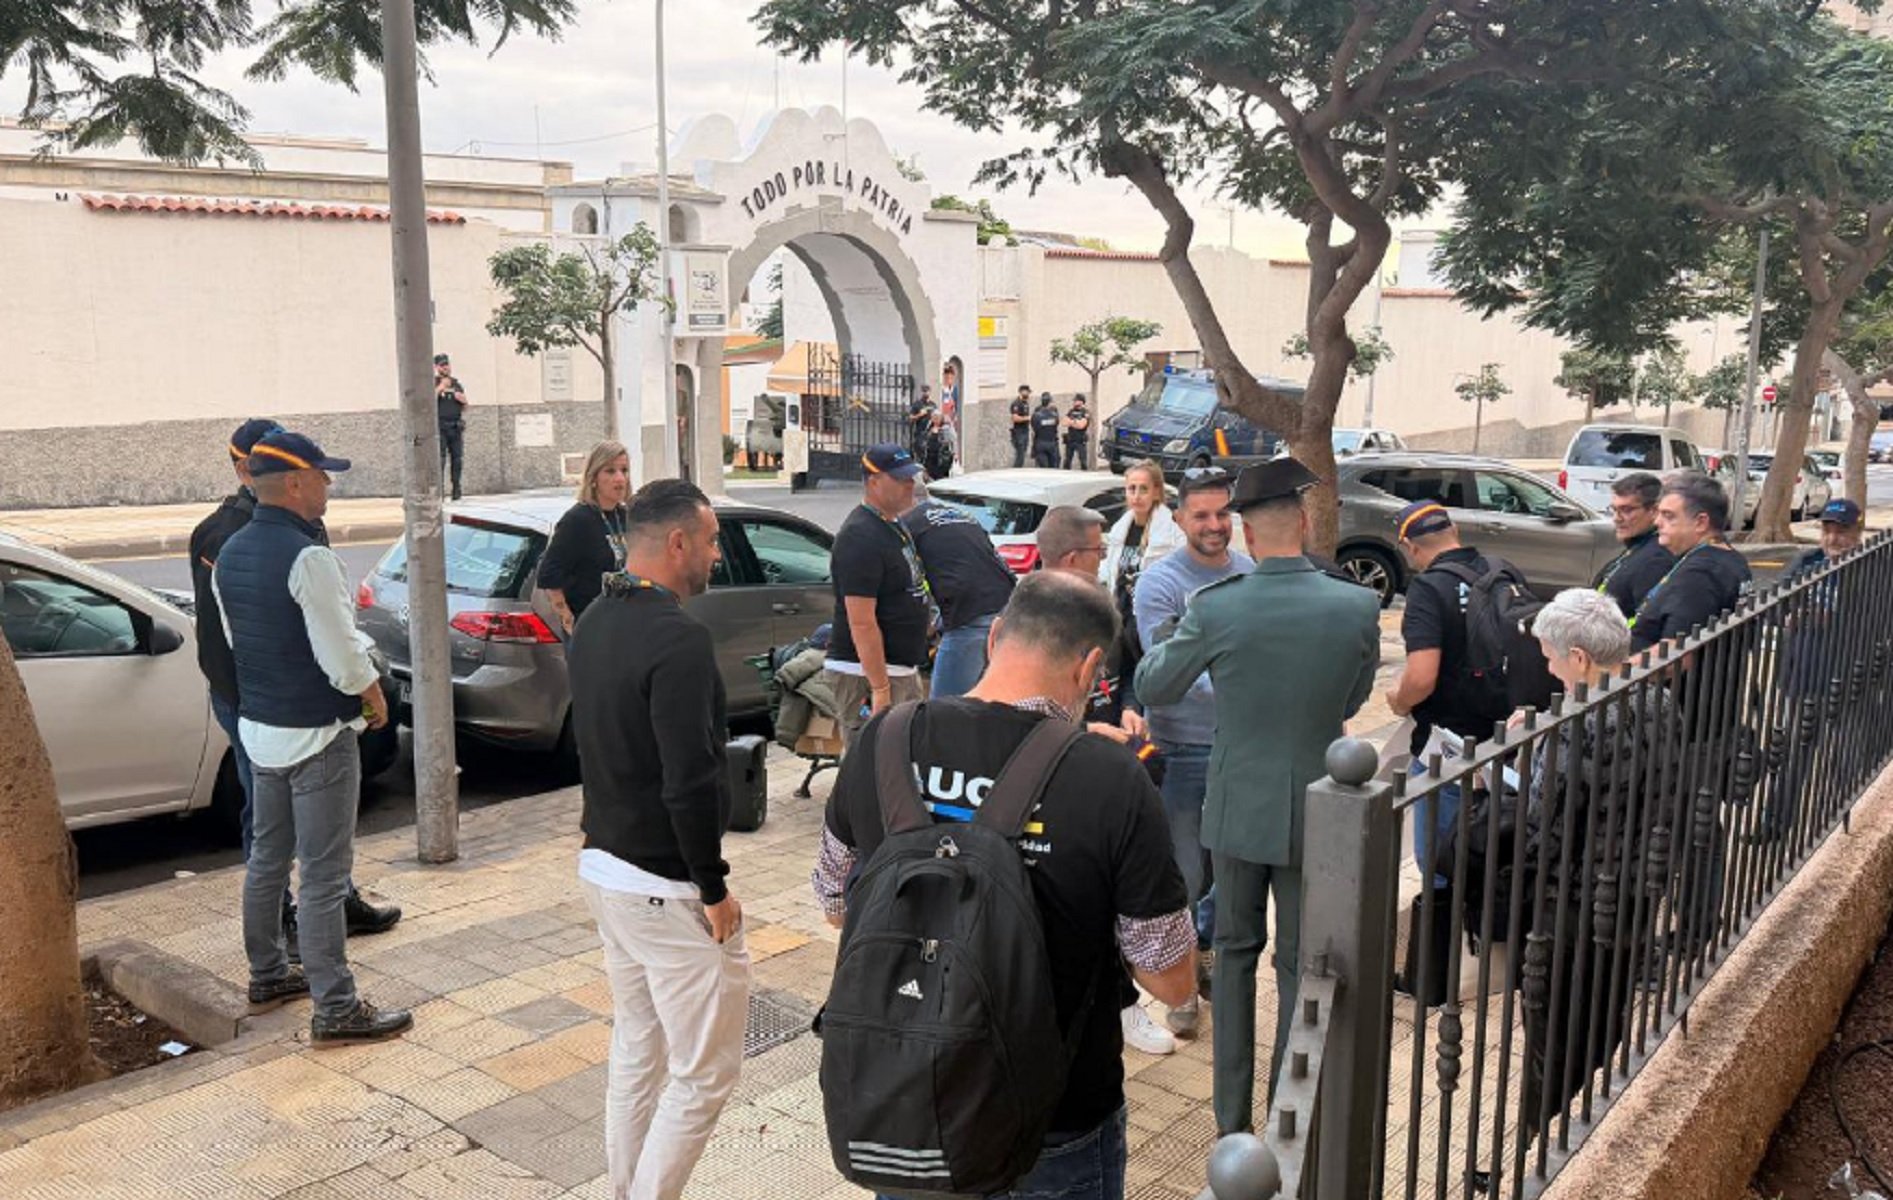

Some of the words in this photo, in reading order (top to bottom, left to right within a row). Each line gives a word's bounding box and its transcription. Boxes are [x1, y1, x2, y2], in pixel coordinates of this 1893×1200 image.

[741, 171, 787, 218] TODO
[792, 160, 825, 189] POR
[834, 162, 854, 192] LA
[860, 176, 912, 234] PATRIA
